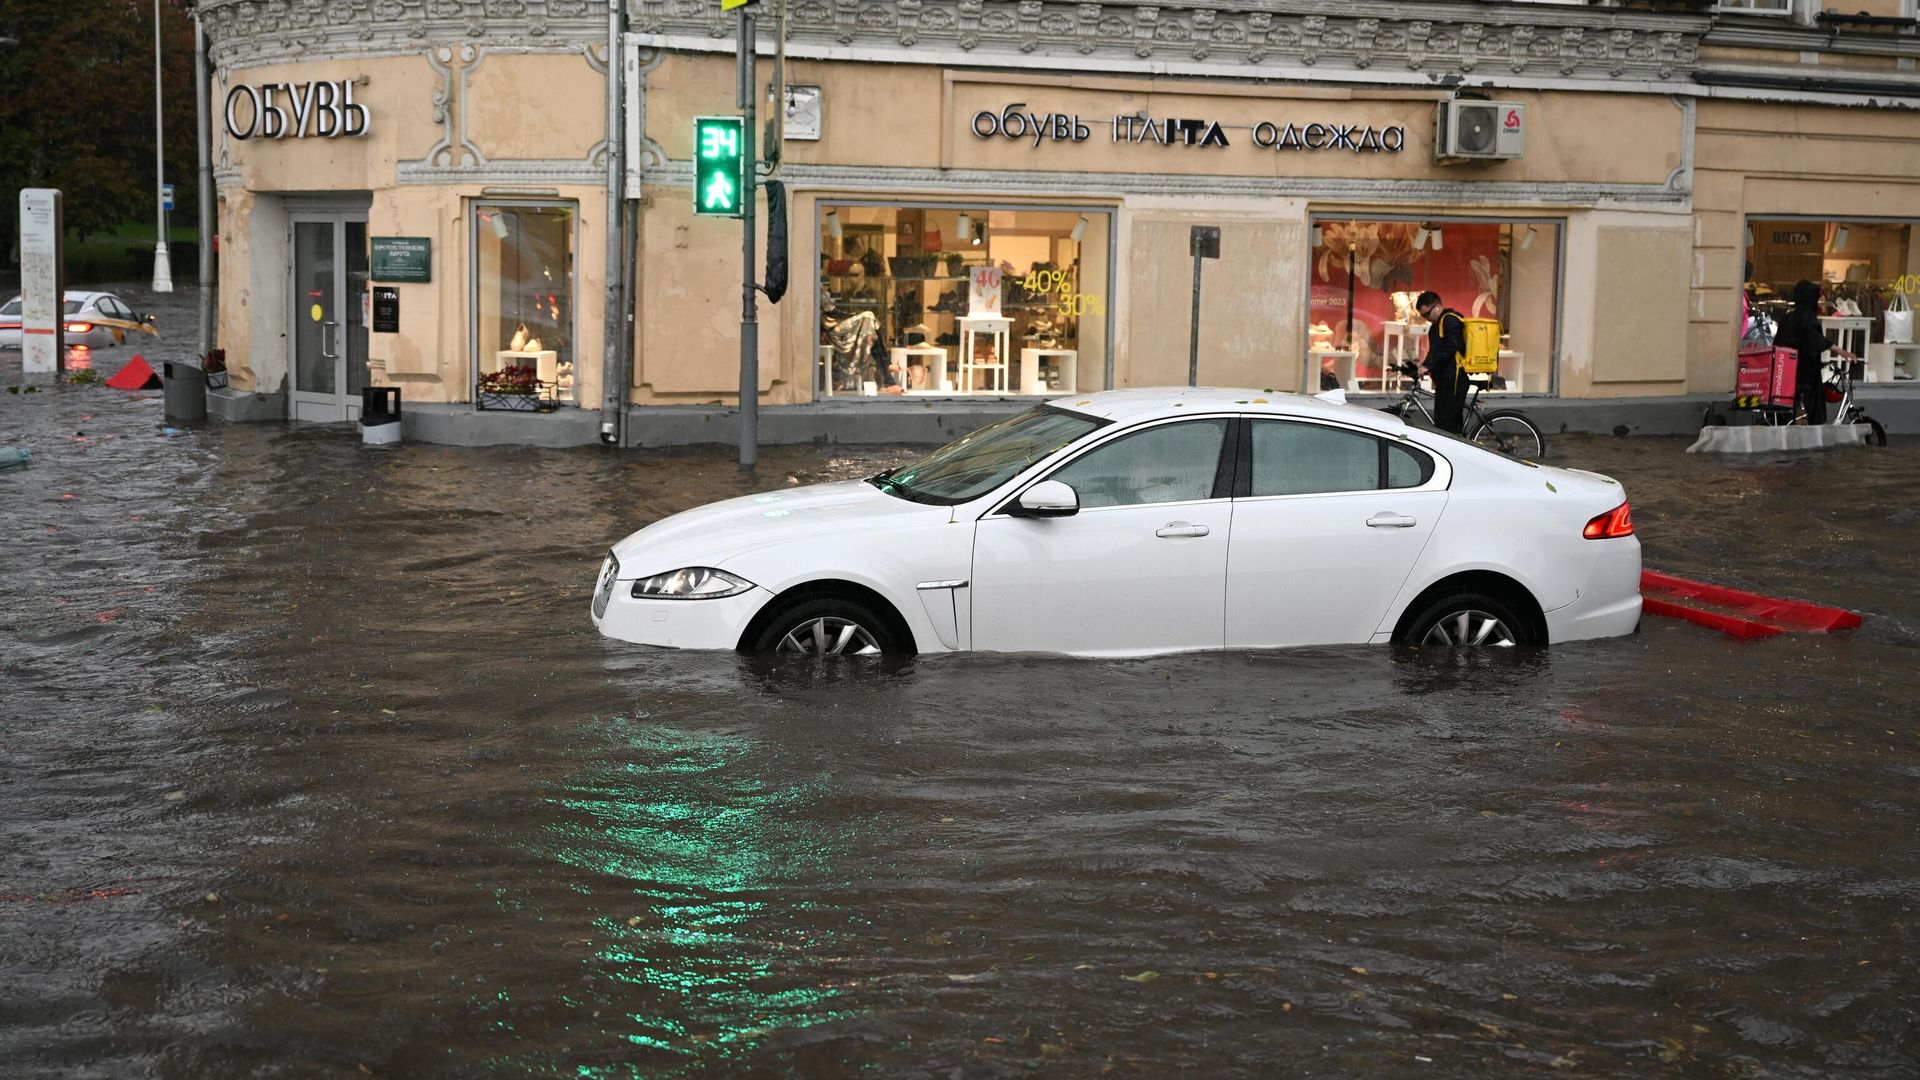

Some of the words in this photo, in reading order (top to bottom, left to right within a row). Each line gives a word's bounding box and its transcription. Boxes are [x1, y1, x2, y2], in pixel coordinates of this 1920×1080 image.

[225, 80, 371, 140] ОБУВЬ
[971, 103, 1091, 147] обувь
[1252, 121, 1404, 153] одежда
[702, 127, 736, 157] 34
[1015, 270, 1071, 293] -40%
